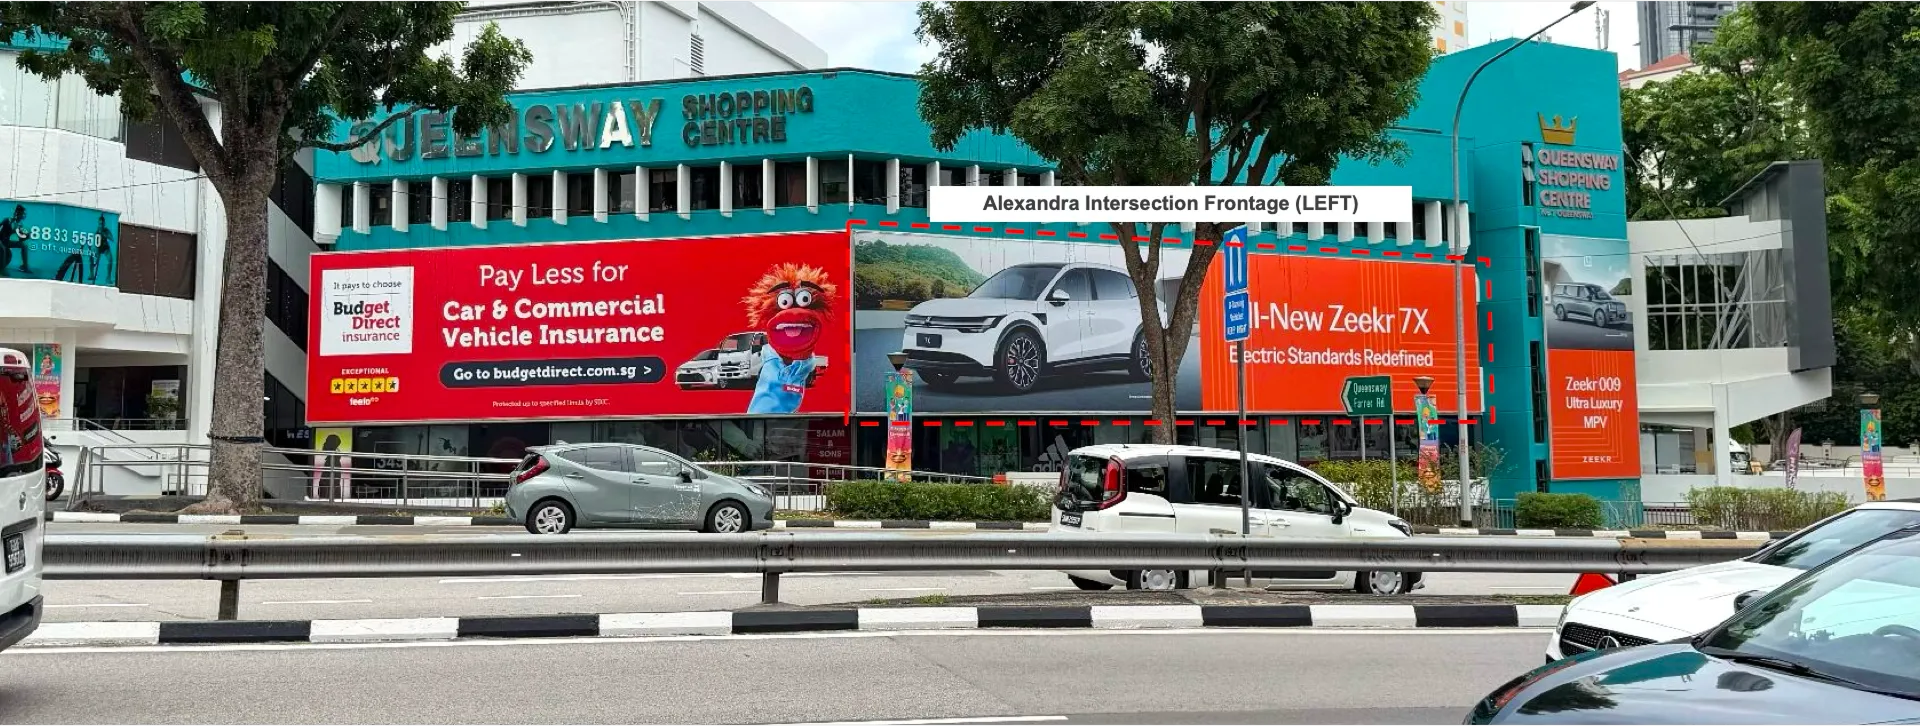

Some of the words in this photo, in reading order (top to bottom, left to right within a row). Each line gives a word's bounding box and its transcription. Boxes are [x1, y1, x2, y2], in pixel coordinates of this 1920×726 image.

[681, 86, 814, 120] SHOPPING
[682, 115, 786, 147] CENTRE
[1538, 149, 1619, 171] QUEENSWAY
[1539, 169, 1612, 191] SHOPPING
[1540, 189, 1592, 209] CENTRE
[479, 264, 523, 291] Pay
[532, 263, 584, 286] Less
[592, 261, 629, 283] for
[333, 282, 340, 290] It
[341, 283, 360, 291] pays
[362, 281, 370, 289] to
[372, 280, 402, 289] choose
[333, 300, 390, 318] Budget
[443, 300, 485, 321] Car
[492, 299, 508, 320] &
[514, 294, 665, 319] Commercial
[352, 315, 401, 330] Direct
[1249, 301, 1324, 331] ll-New
[1328, 303, 1396, 333] Zeekr
[1398, 307, 1431, 335] 7X
[342, 331, 400, 342] insurance
[442, 325, 533, 348] Vehicle
[539, 324, 665, 346] Insurance
[1229, 346, 1286, 364] Eectric
[1287, 346, 1362, 366] Standards
[1363, 348, 1433, 367] Redefined
[341, 367, 390, 375] EXCEPTIONAL
[453, 367, 473, 381] Go
[476, 367, 490, 380] to
[493, 364, 637, 382] budgetdirect.com.sg
[1353, 382, 1387, 395] Queensway
[1565, 376, 1598, 391] Zeekr
[1599, 376, 1622, 392] 009
[1566, 396, 1589, 409] Ultra
[1590, 396, 1623, 413] Luxury
[1583, 415, 1608, 429] MPV
[816, 429, 845, 438] SALAM
[818, 450, 842, 458] SONS
[1583, 455, 1612, 463] ZEEKR
